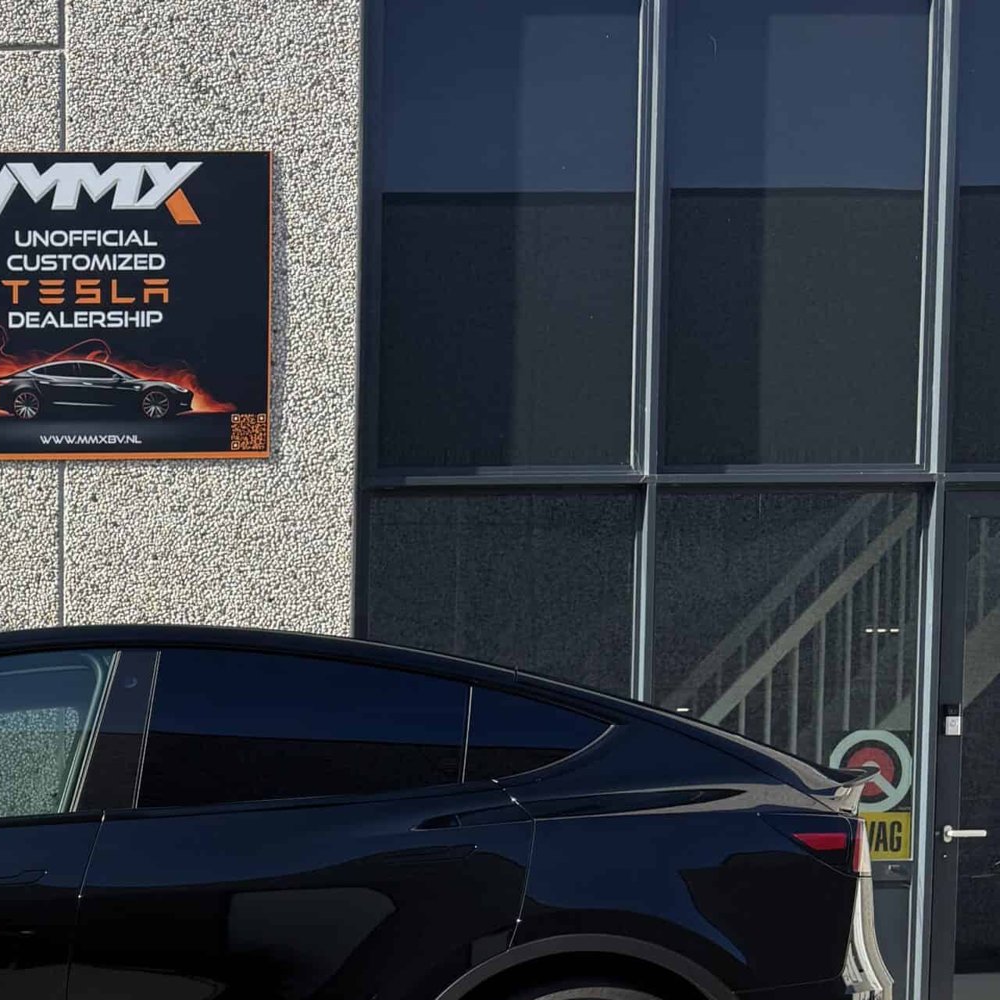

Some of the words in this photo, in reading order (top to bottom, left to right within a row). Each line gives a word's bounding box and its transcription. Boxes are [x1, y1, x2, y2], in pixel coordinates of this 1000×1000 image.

[14, 229, 158, 248] UNOFFICIAL
[6, 253, 166, 272] CUSTOMIZED
[1, 278, 170, 305] TESLA
[8, 310, 164, 329] DEALERSHIP
[40, 434, 143, 445] WWW.MMXBV.NL
[866, 820, 903, 852] VAG
